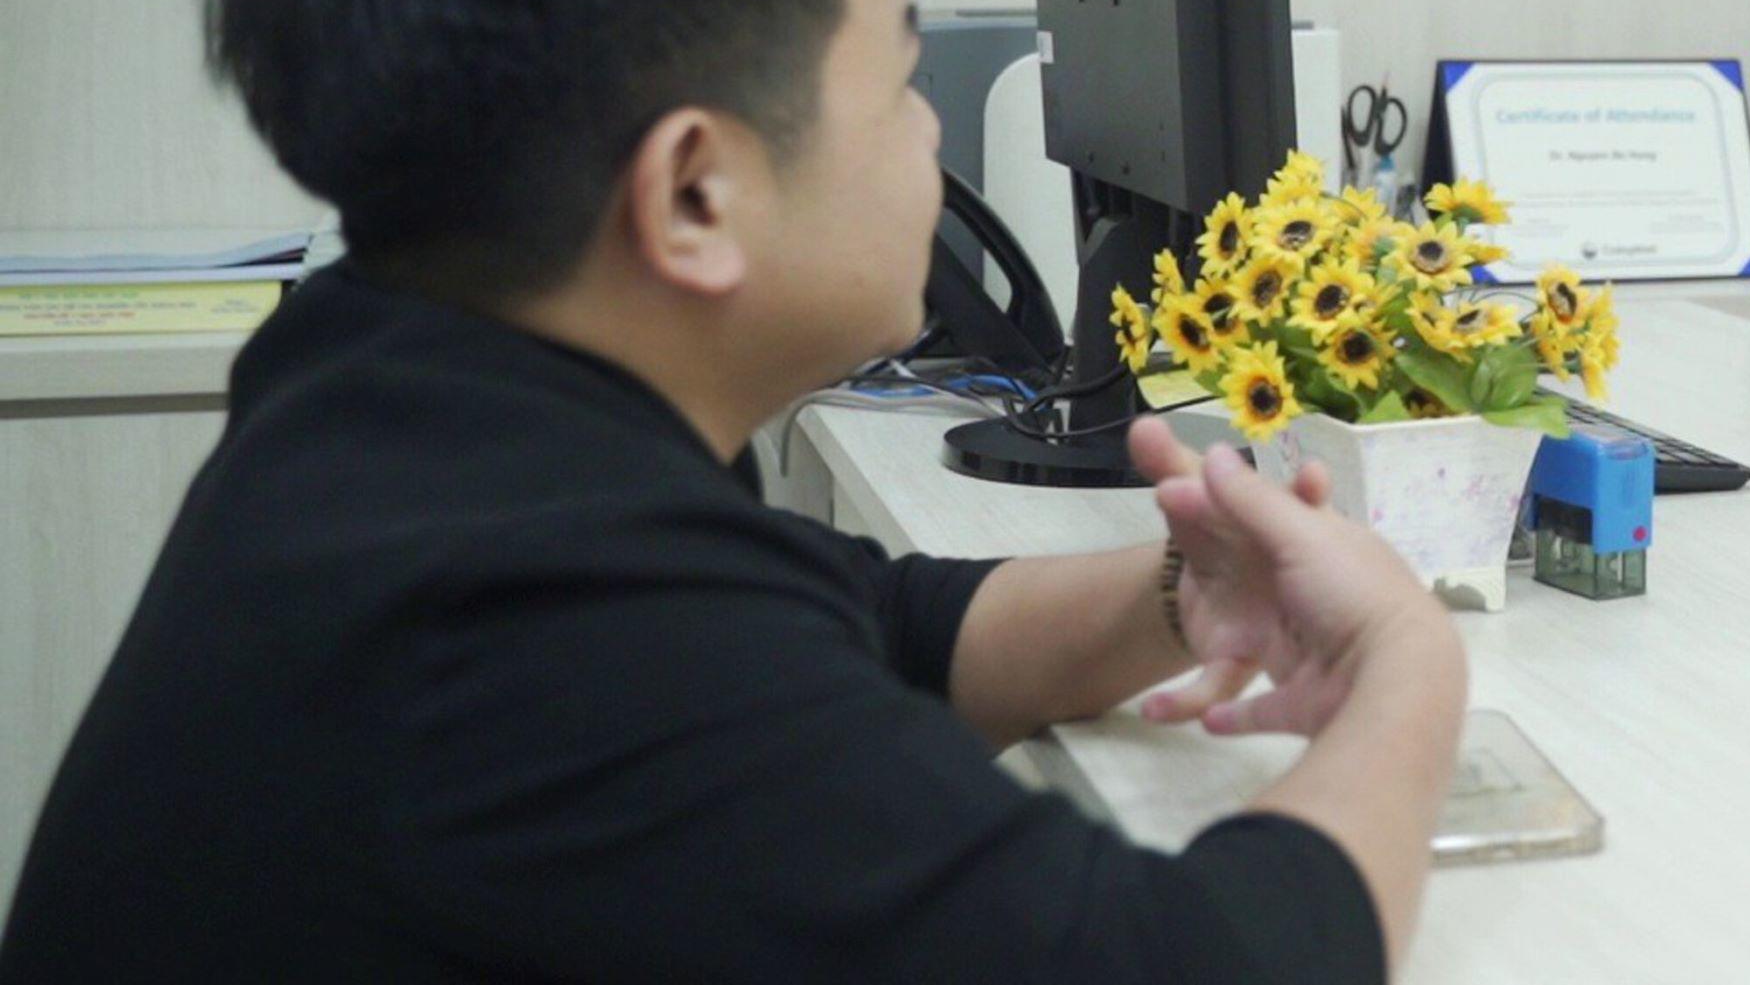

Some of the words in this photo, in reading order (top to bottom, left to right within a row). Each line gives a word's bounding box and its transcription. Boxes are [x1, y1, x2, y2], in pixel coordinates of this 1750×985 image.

[1496, 106, 1579, 124] Certificate
[1583, 106, 1601, 124] of
[1606, 106, 1695, 124] Attendance
